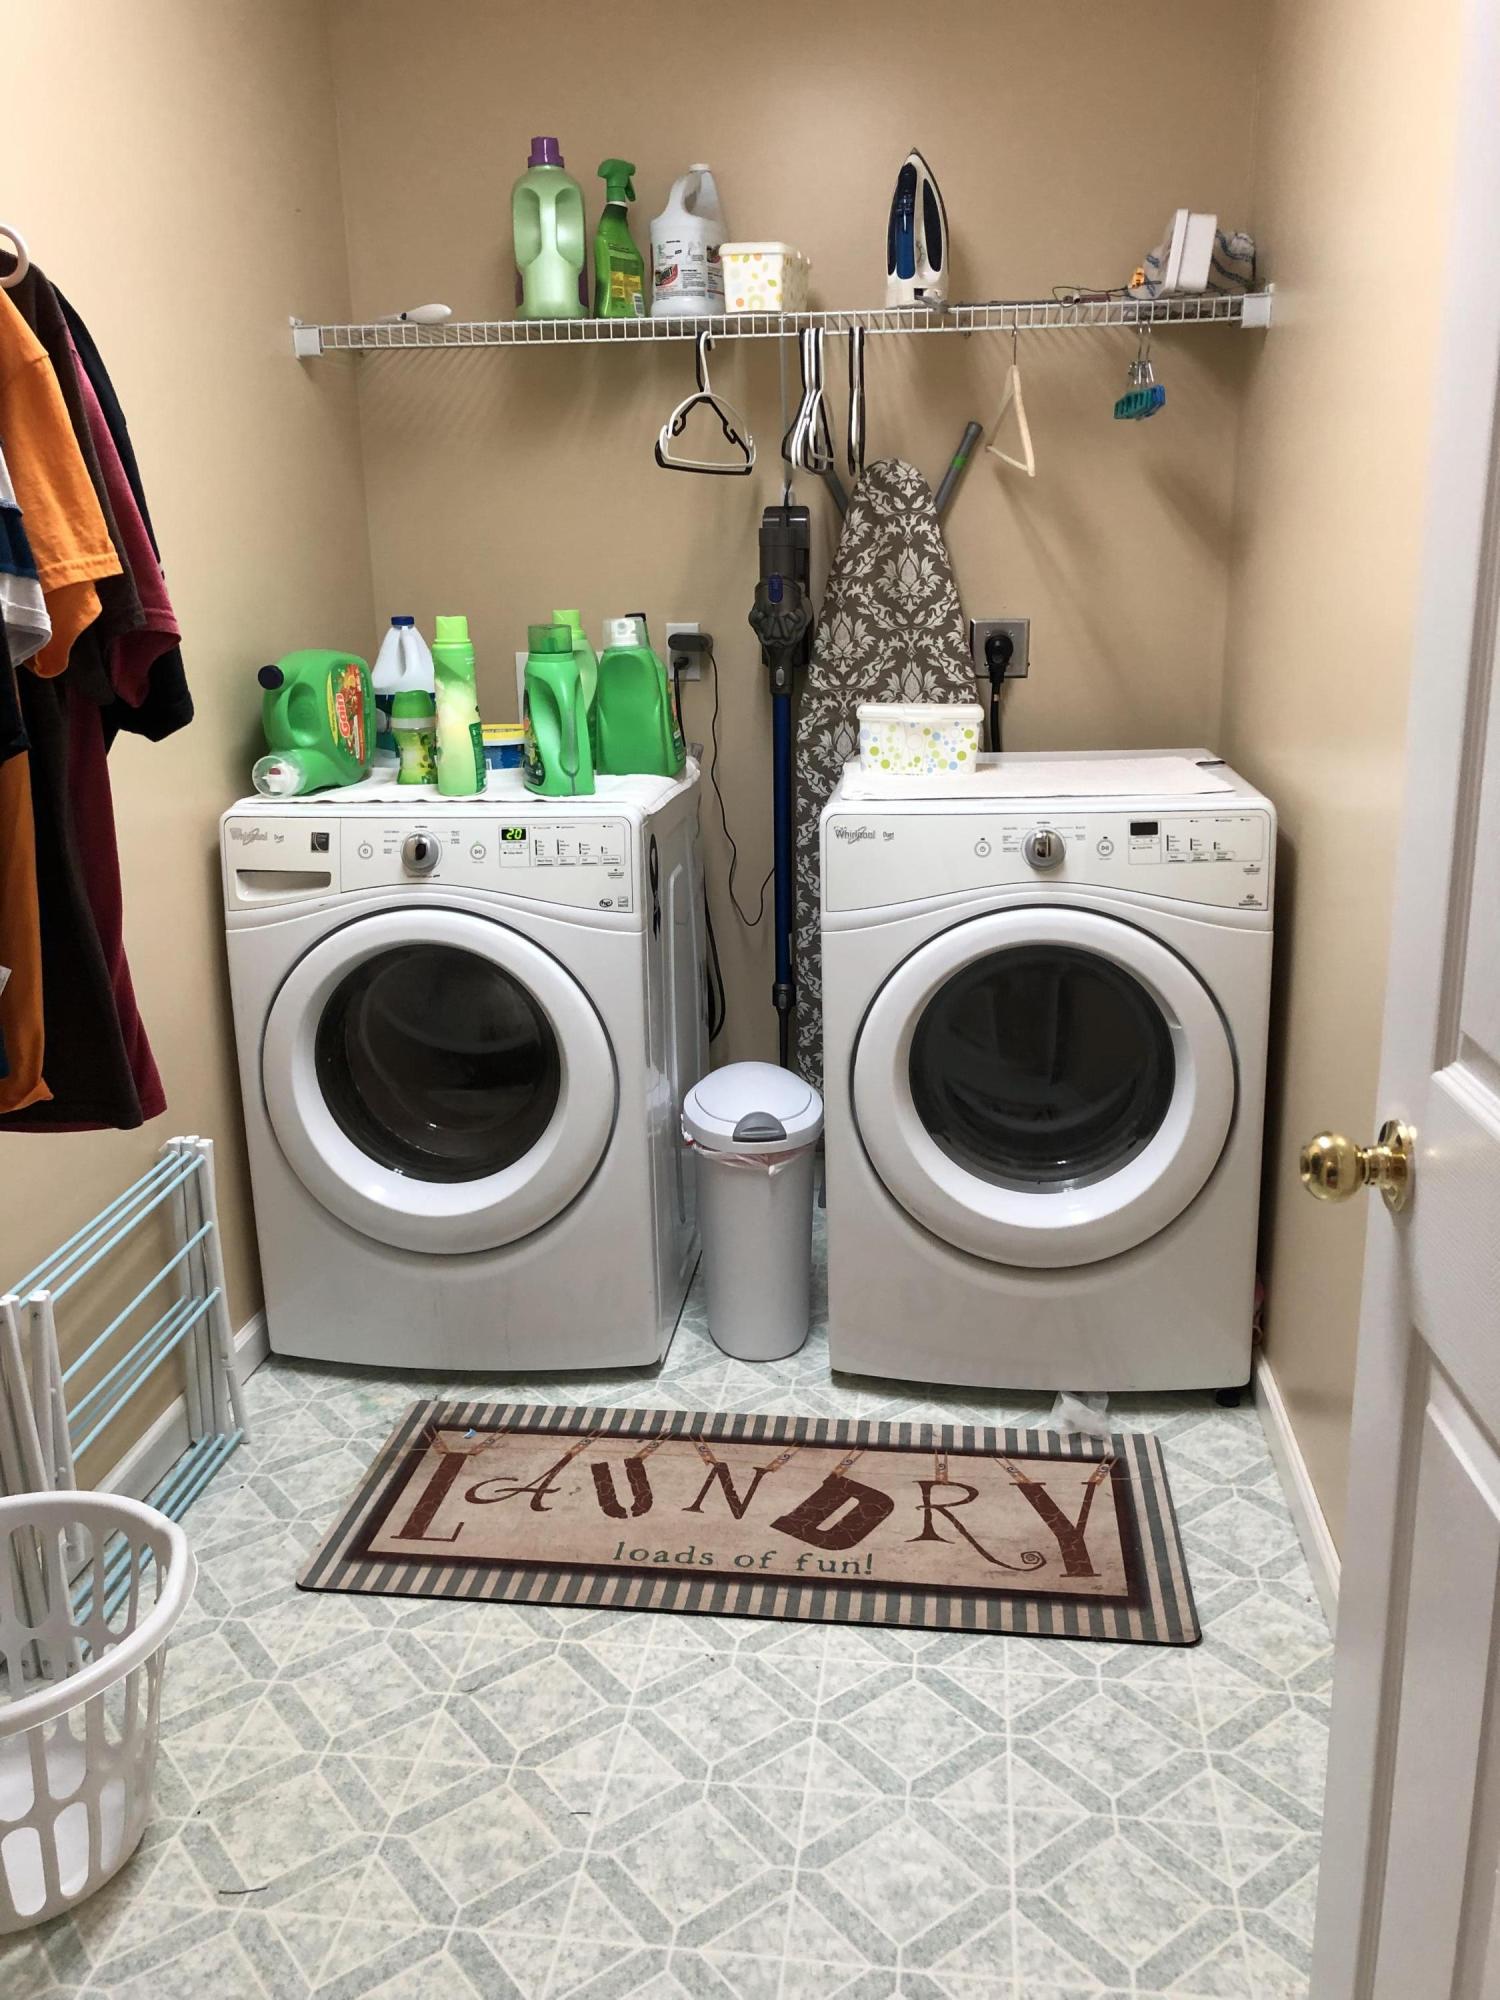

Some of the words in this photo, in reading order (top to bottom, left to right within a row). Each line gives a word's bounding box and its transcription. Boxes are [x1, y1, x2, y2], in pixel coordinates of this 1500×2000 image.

[336, 692, 350, 738] Gain
[506, 827, 523, 840] 20
[834, 826, 876, 845] Whirlpool
[389, 1453, 1102, 1577] LAUNDRY
[612, 1541, 713, 1566] loads
[734, 1550, 777, 1569] of
[795, 1553, 873, 1575] fun!
